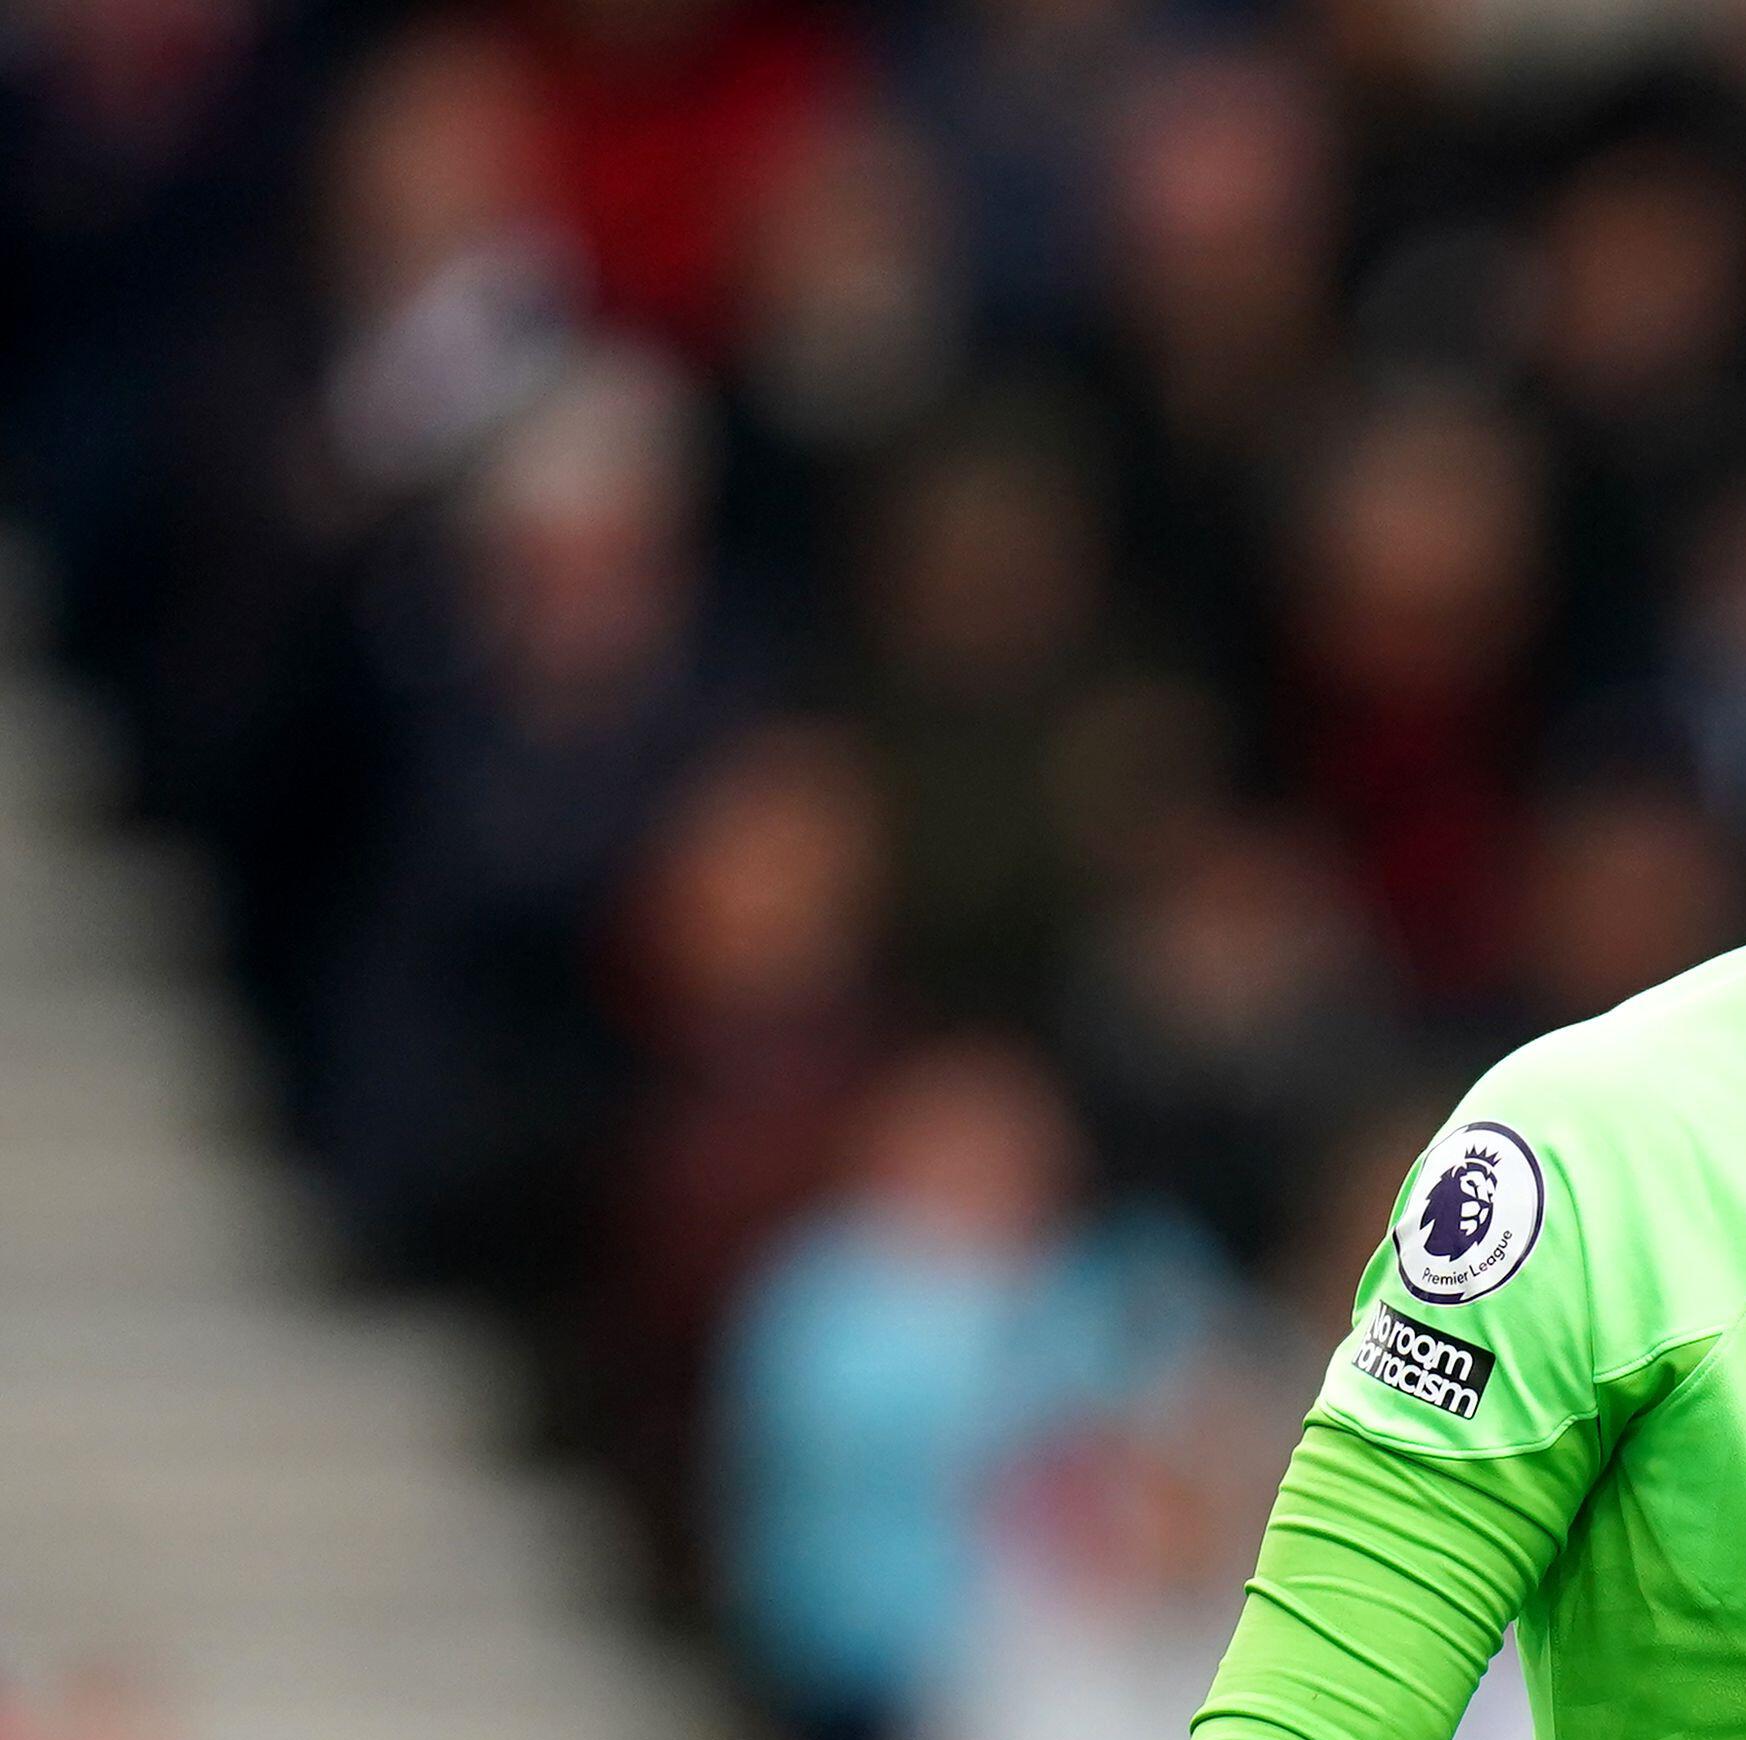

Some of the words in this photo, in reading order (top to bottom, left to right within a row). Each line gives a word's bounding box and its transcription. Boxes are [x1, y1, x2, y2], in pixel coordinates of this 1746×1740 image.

[1422, 1267, 1469, 1286] Premier
[1469, 1230, 1513, 1278] League
[1387, 1320, 1474, 1381] room
[1374, 1351, 1479, 1418] racism
